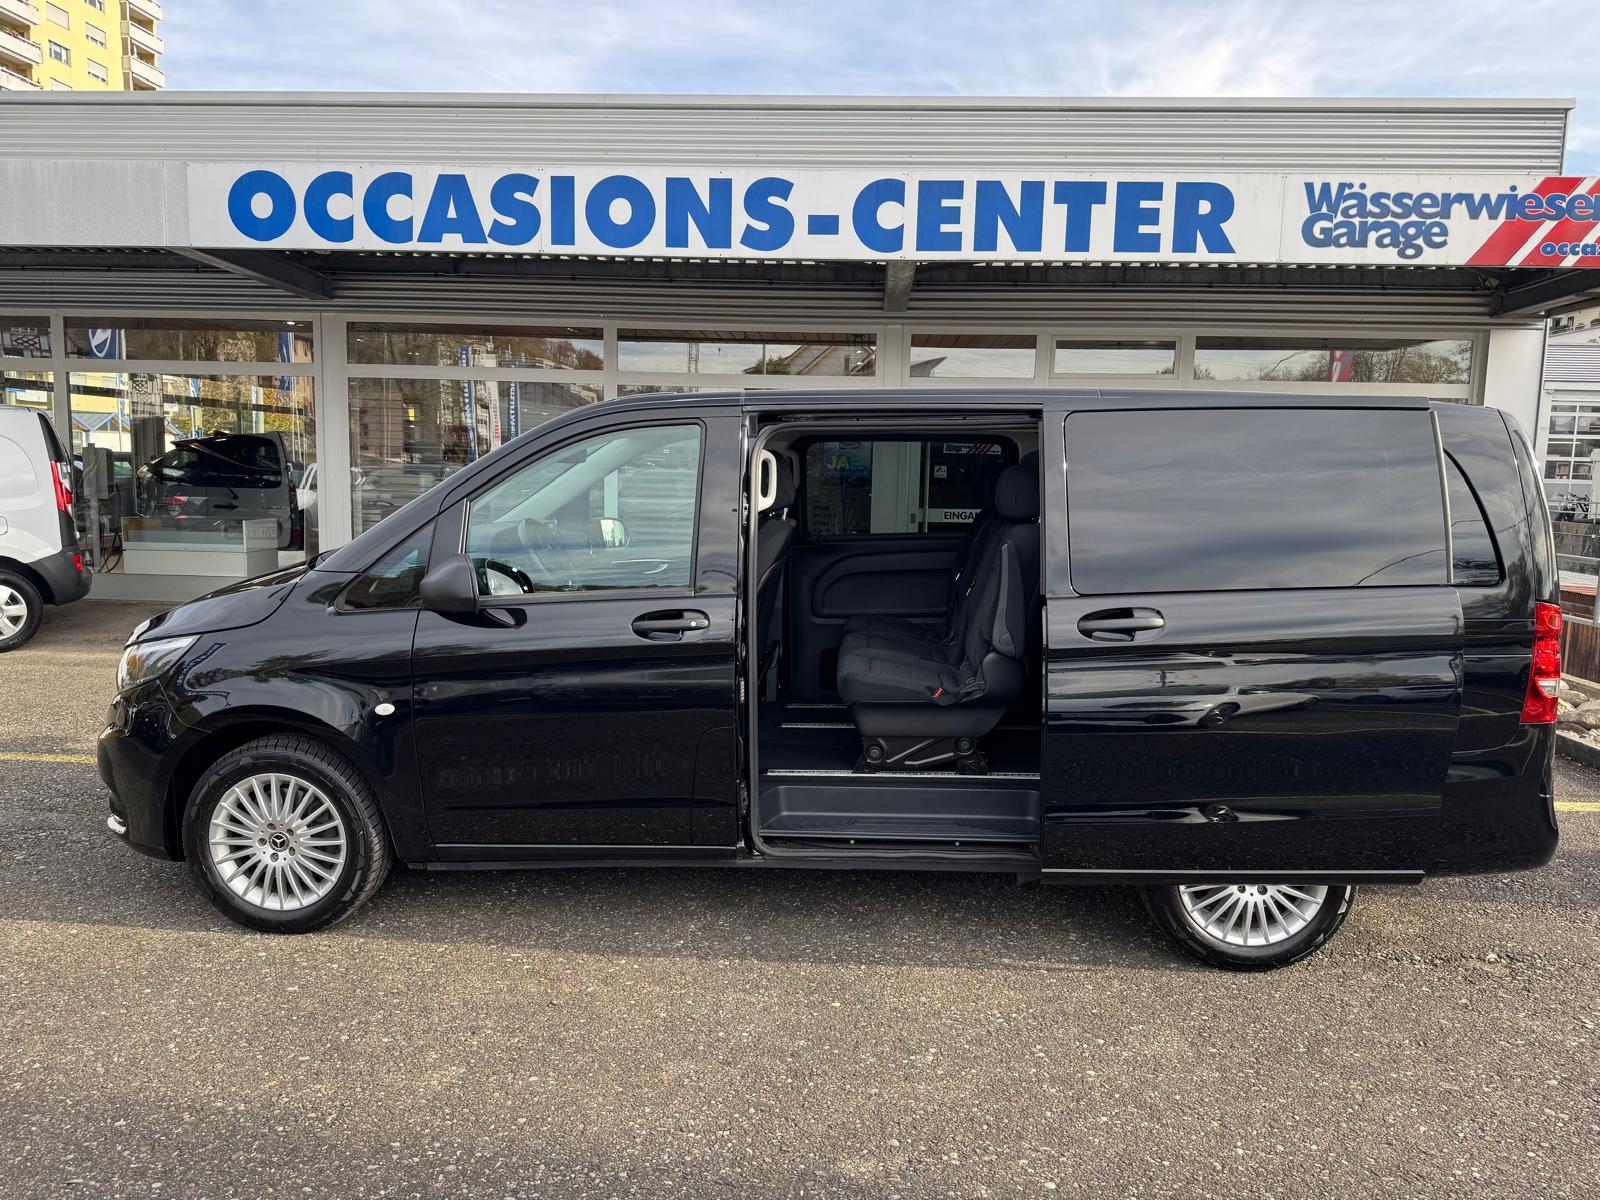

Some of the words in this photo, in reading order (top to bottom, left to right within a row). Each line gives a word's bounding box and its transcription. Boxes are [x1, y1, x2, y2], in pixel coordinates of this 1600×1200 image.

[228, 169, 1236, 254] OCCASIONS-CENTER
[1301, 212, 1448, 260] Garage
[1540, 242, 1600, 256] occa
[944, 511, 981, 521] EINGA
